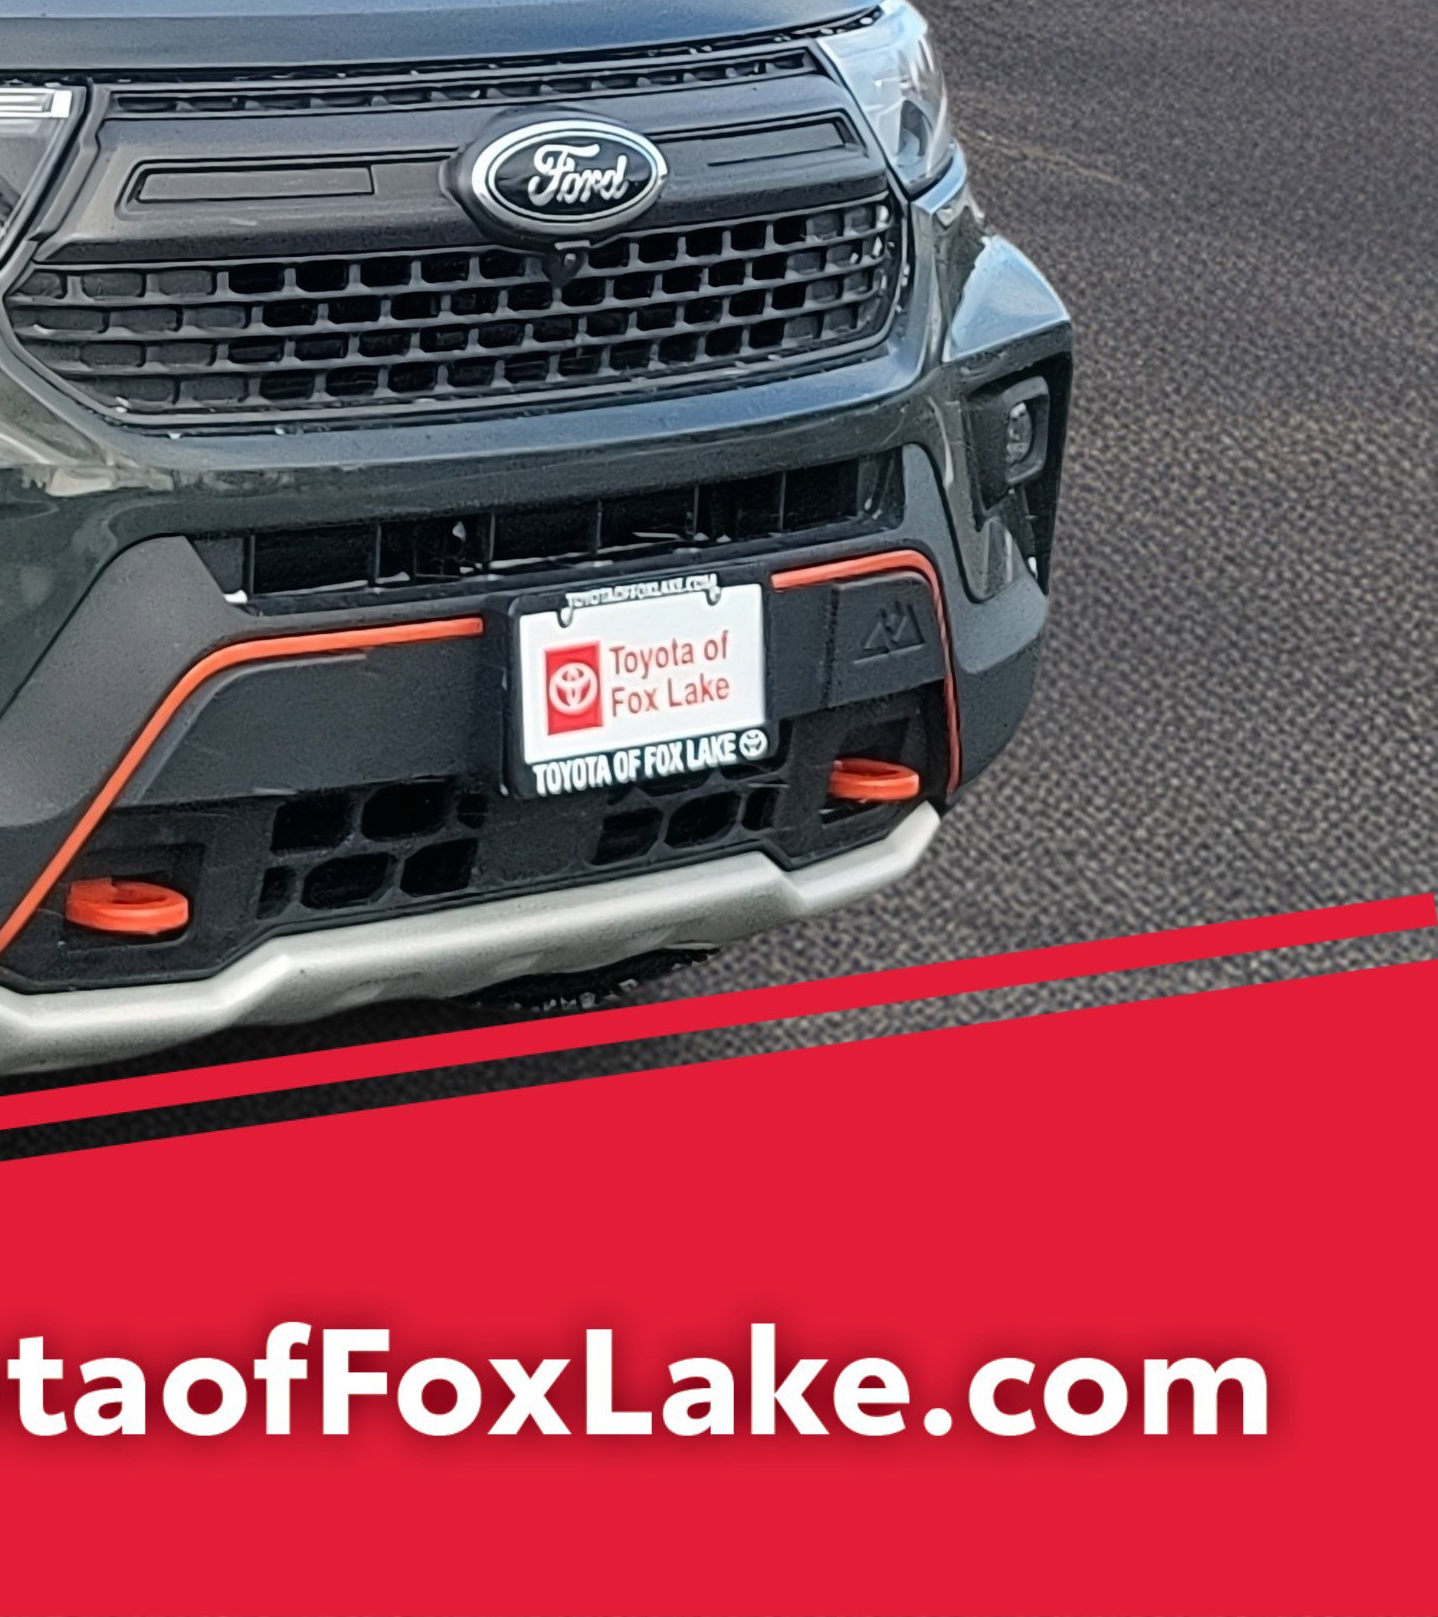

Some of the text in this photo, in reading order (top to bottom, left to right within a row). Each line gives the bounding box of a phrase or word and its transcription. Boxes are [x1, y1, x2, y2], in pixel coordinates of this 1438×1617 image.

[527, 143, 629, 207] Ford
[609, 629, 729, 679] Toyota of
[611, 672, 730, 718] Fox Lake
[532, 732, 737, 797] TOYOTA OF FOX LAKE
